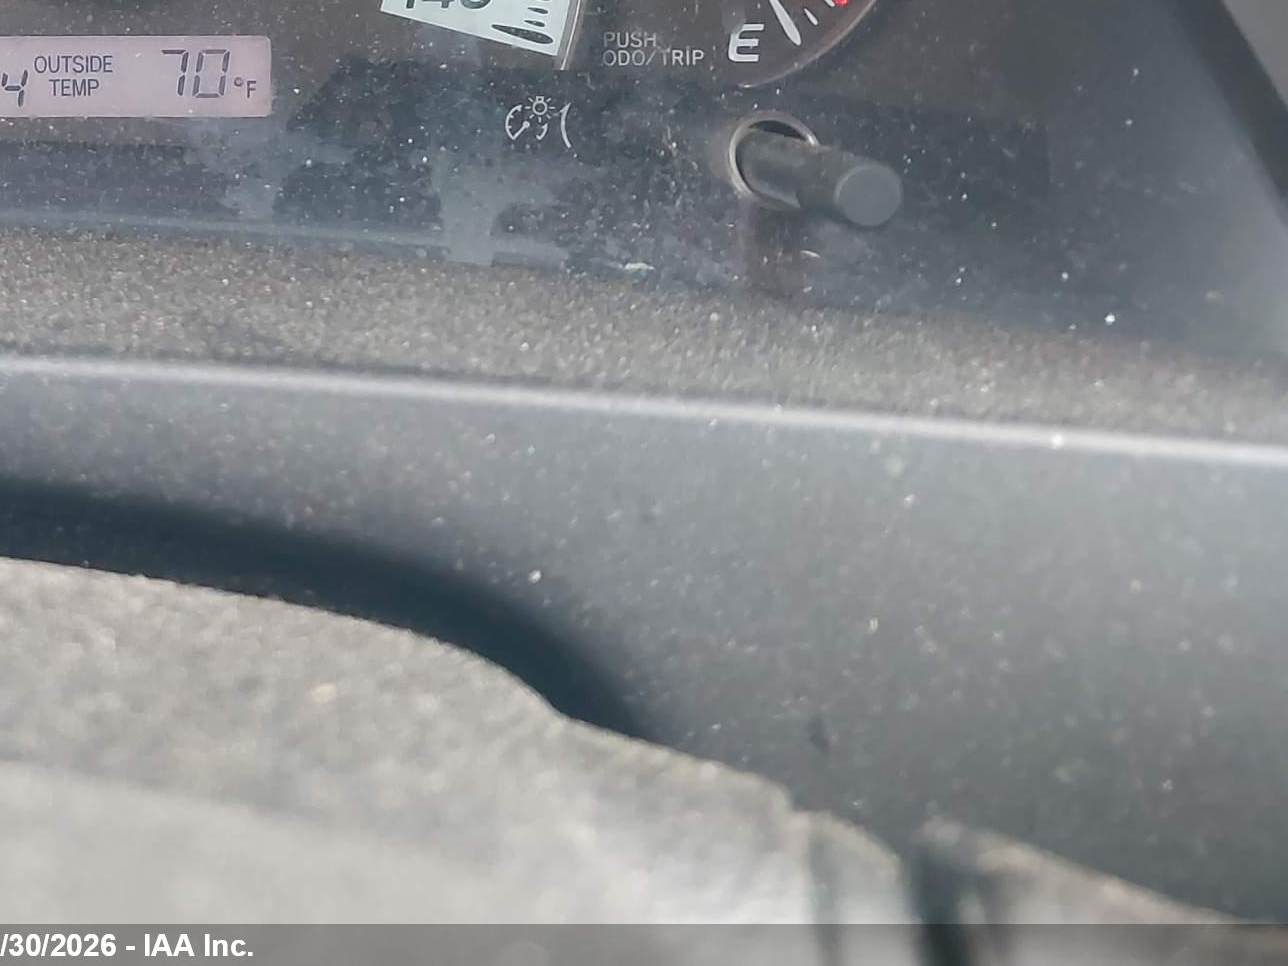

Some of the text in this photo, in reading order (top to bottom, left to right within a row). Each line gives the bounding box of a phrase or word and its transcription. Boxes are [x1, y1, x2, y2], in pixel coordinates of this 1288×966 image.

[603, 33, 656, 48] PUSH
[728, 23, 765, 62] E
[34, 55, 113, 74] OUTSIDE
[602, 49, 704, 66] ODO/TRIP
[48, 78, 100, 97] TEMP
